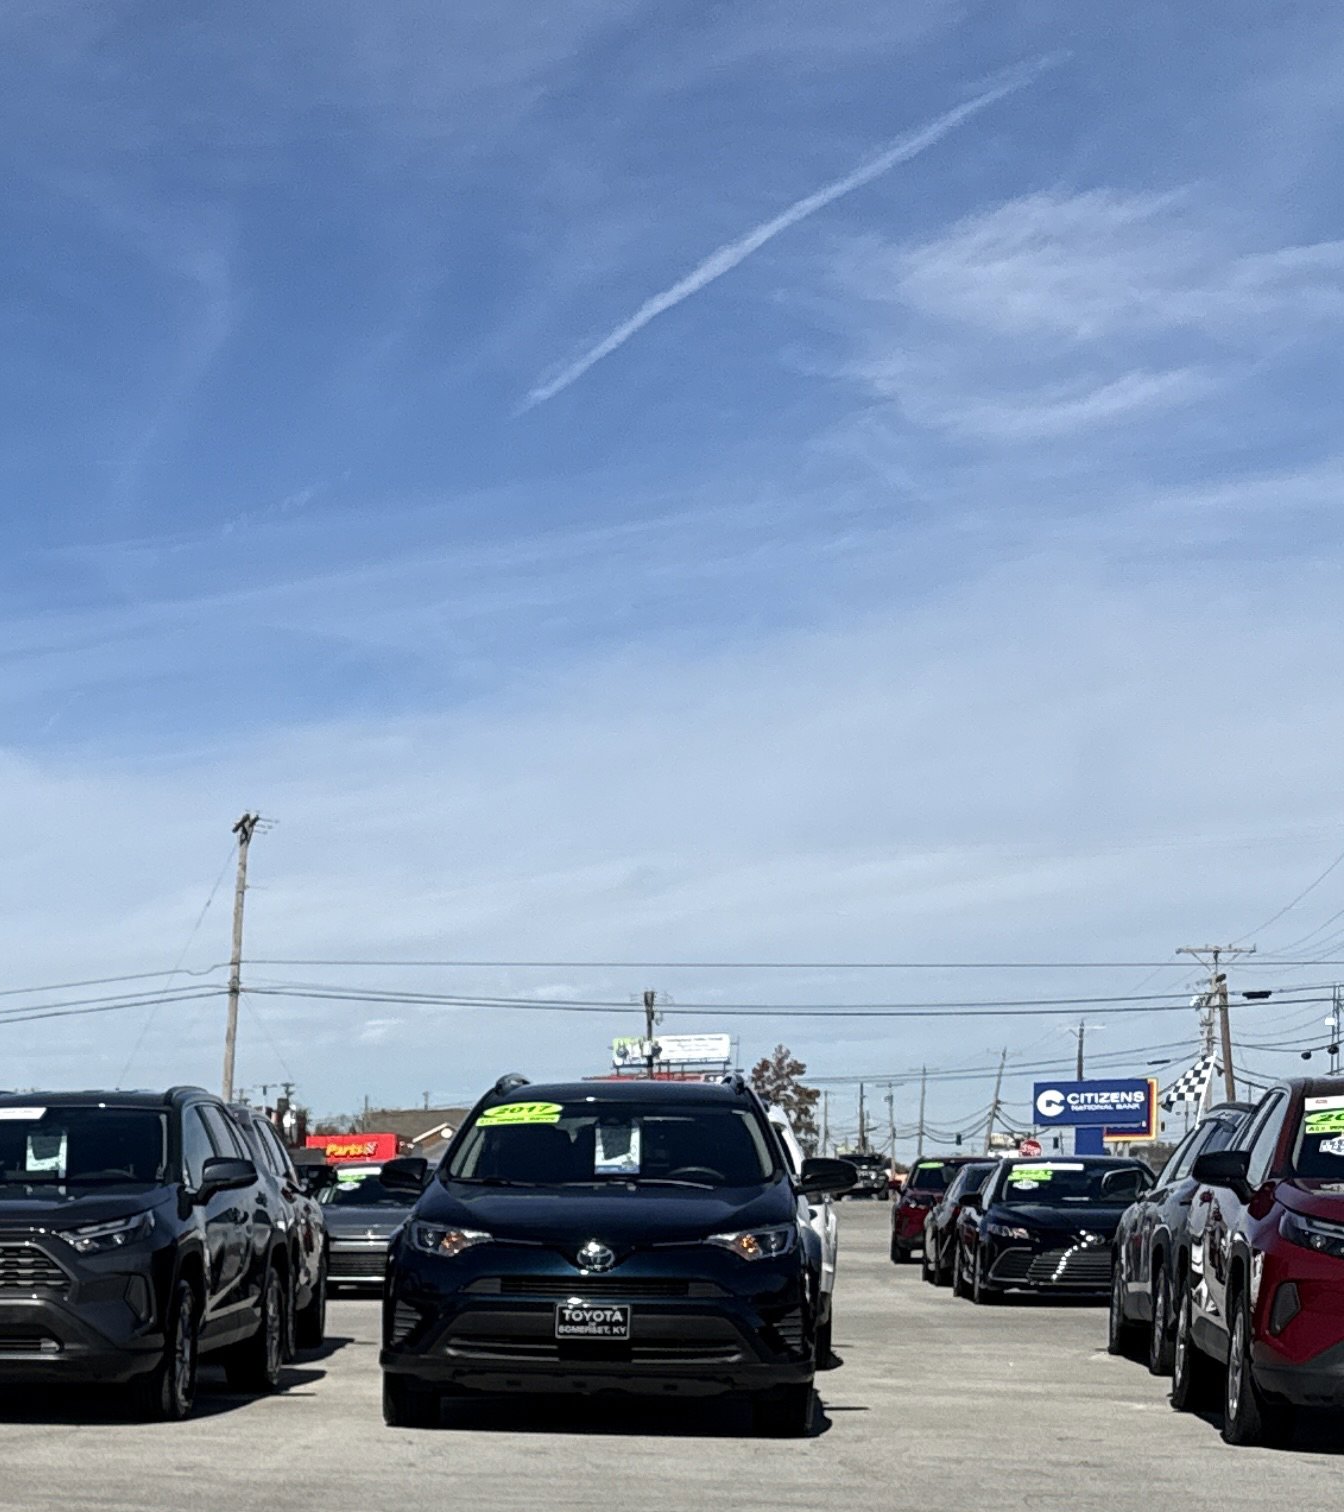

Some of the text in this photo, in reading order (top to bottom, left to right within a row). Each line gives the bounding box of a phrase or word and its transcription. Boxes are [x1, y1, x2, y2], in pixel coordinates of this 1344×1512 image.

[1066, 1091, 1145, 1105] CITIZENS
[494, 1105, 553, 1115] 2017
[1071, 1102, 1140, 1111] NATIONAL BANK
[562, 1310, 623, 1322] TOYOTA
[612, 1326, 627, 1334] KY
